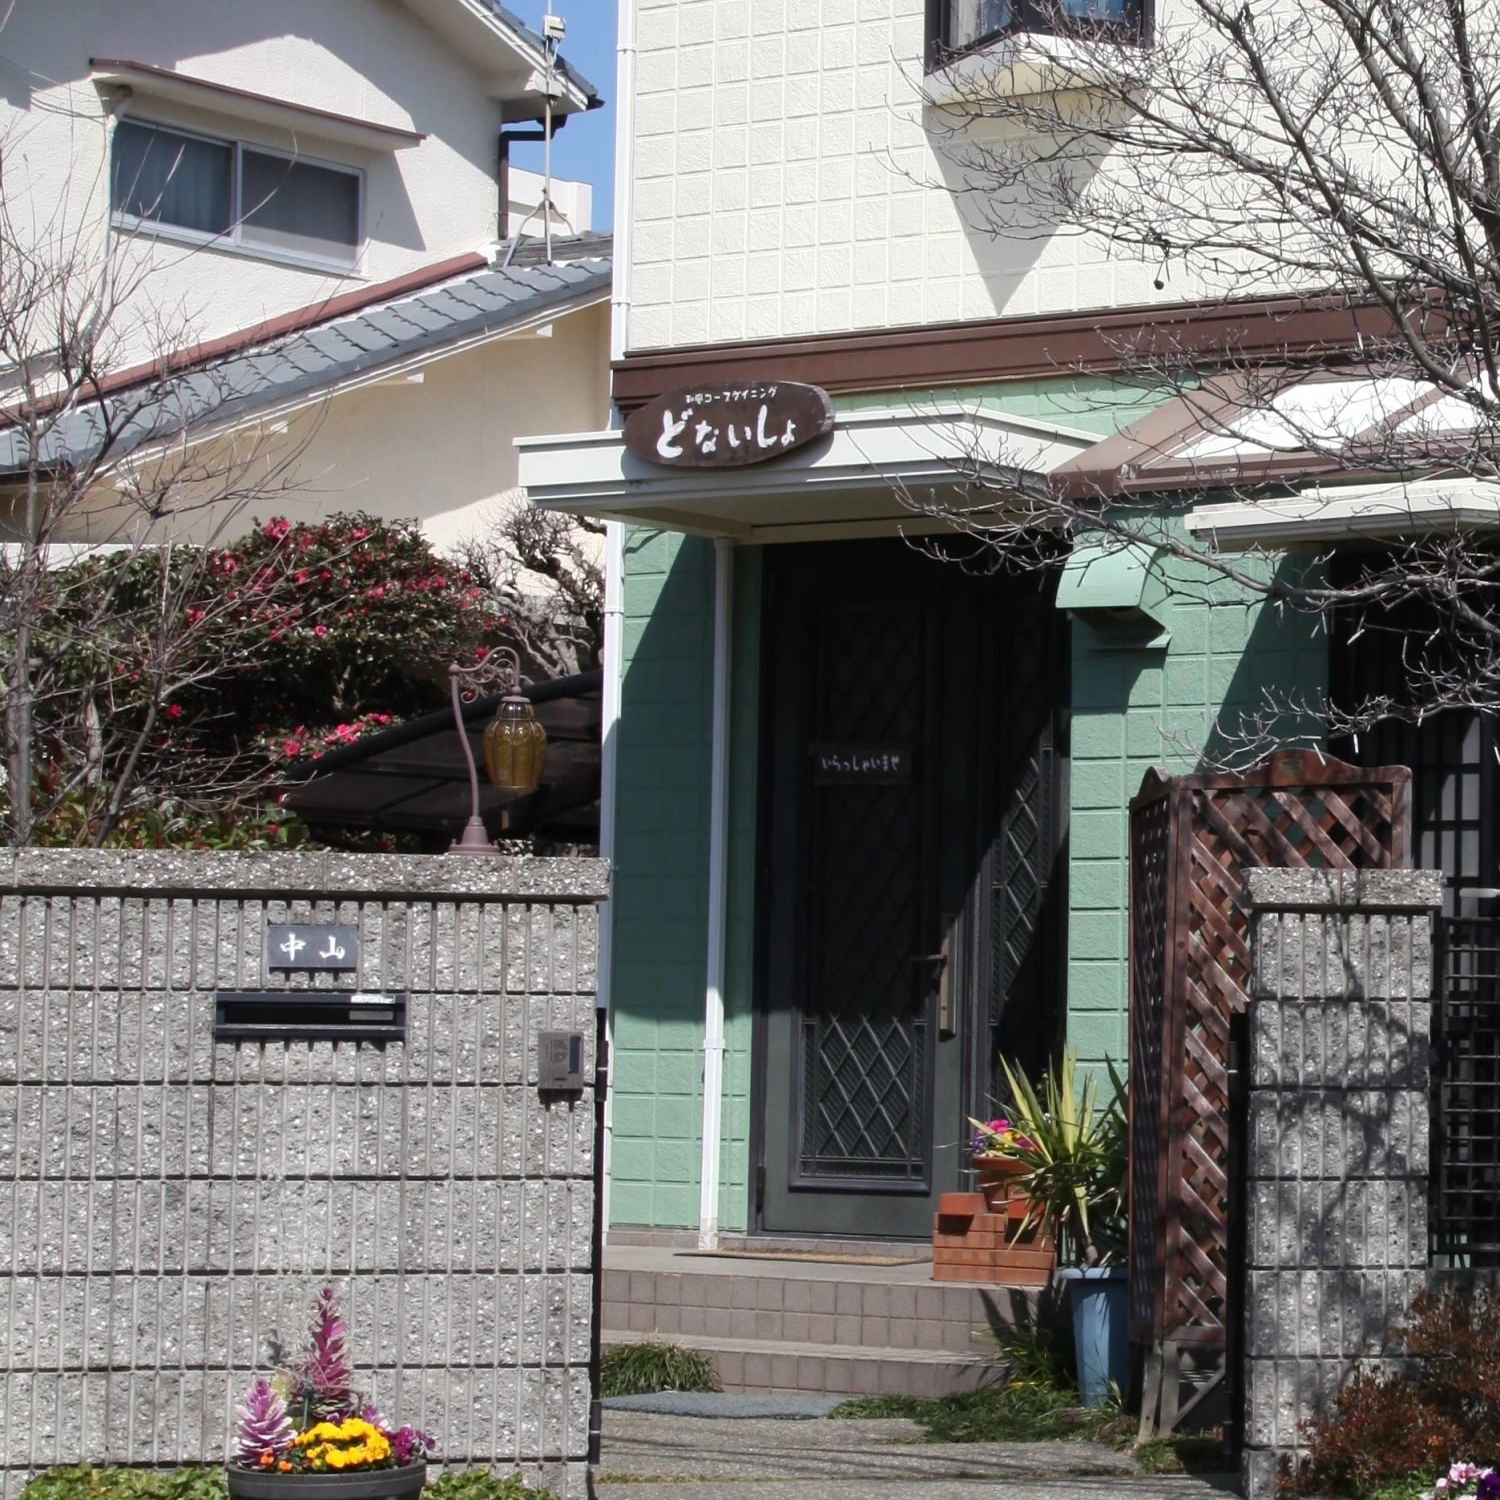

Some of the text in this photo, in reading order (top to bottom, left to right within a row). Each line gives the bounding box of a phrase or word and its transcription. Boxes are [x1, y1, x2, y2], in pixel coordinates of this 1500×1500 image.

[656, 404, 797, 459] どないしょ
[821, 753, 900, 772] いらっしゃいませ
[280, 933, 346, 962] 中山
